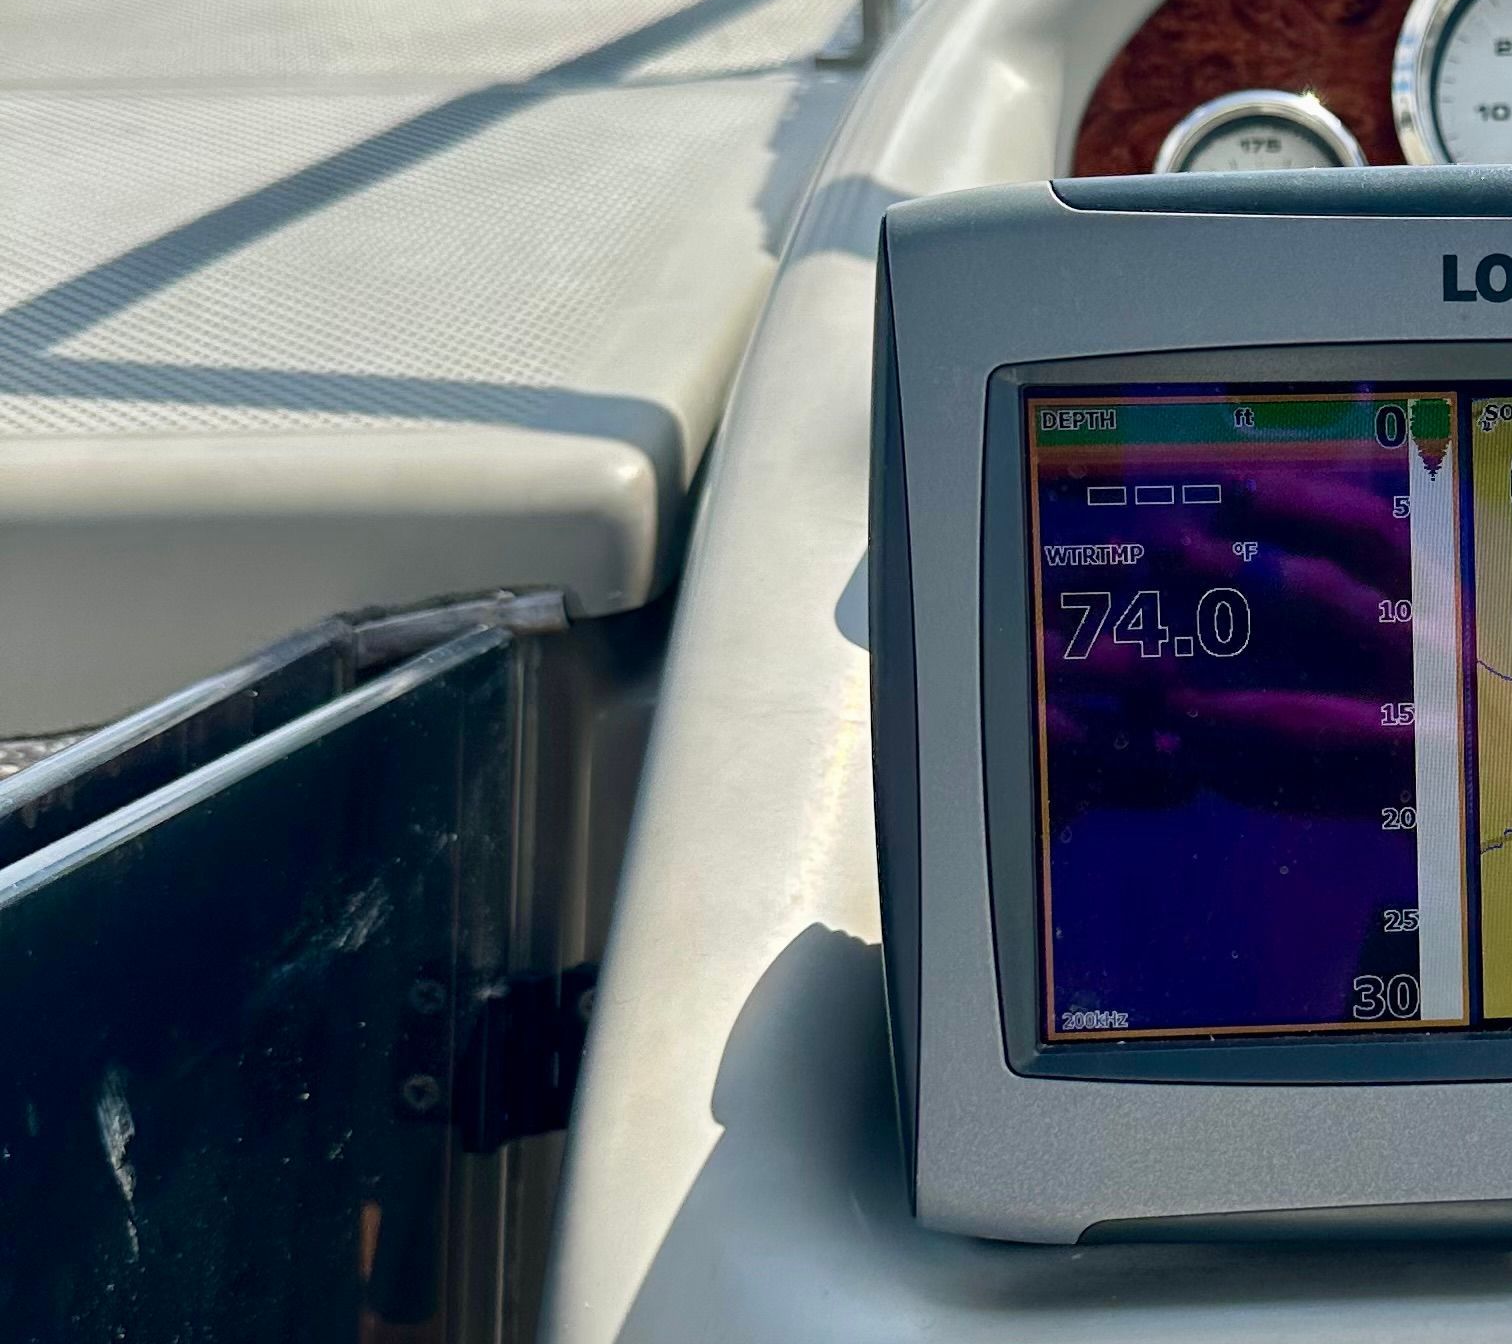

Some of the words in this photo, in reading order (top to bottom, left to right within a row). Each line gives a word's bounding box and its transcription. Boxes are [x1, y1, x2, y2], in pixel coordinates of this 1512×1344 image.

[1474, 102, 1512, 123] 10
[1041, 409, 1116, 430] DEPTH
[1233, 407, 1255, 427] ft
[1375, 404, 1408, 448] 0
[1393, 496, 1411, 518] 5
[1044, 544, 1145, 566] WTRTMP
[1060, 587, 1251, 659] 74.0
[1379, 600, 1413, 623] 10
[1380, 702, 1415, 725] 15
[1381, 807, 1417, 830] 20
[1384, 908, 1420, 932] 25
[1353, 974, 1420, 1019] 30
[1061, 1010, 1129, 1030] 200kHz
